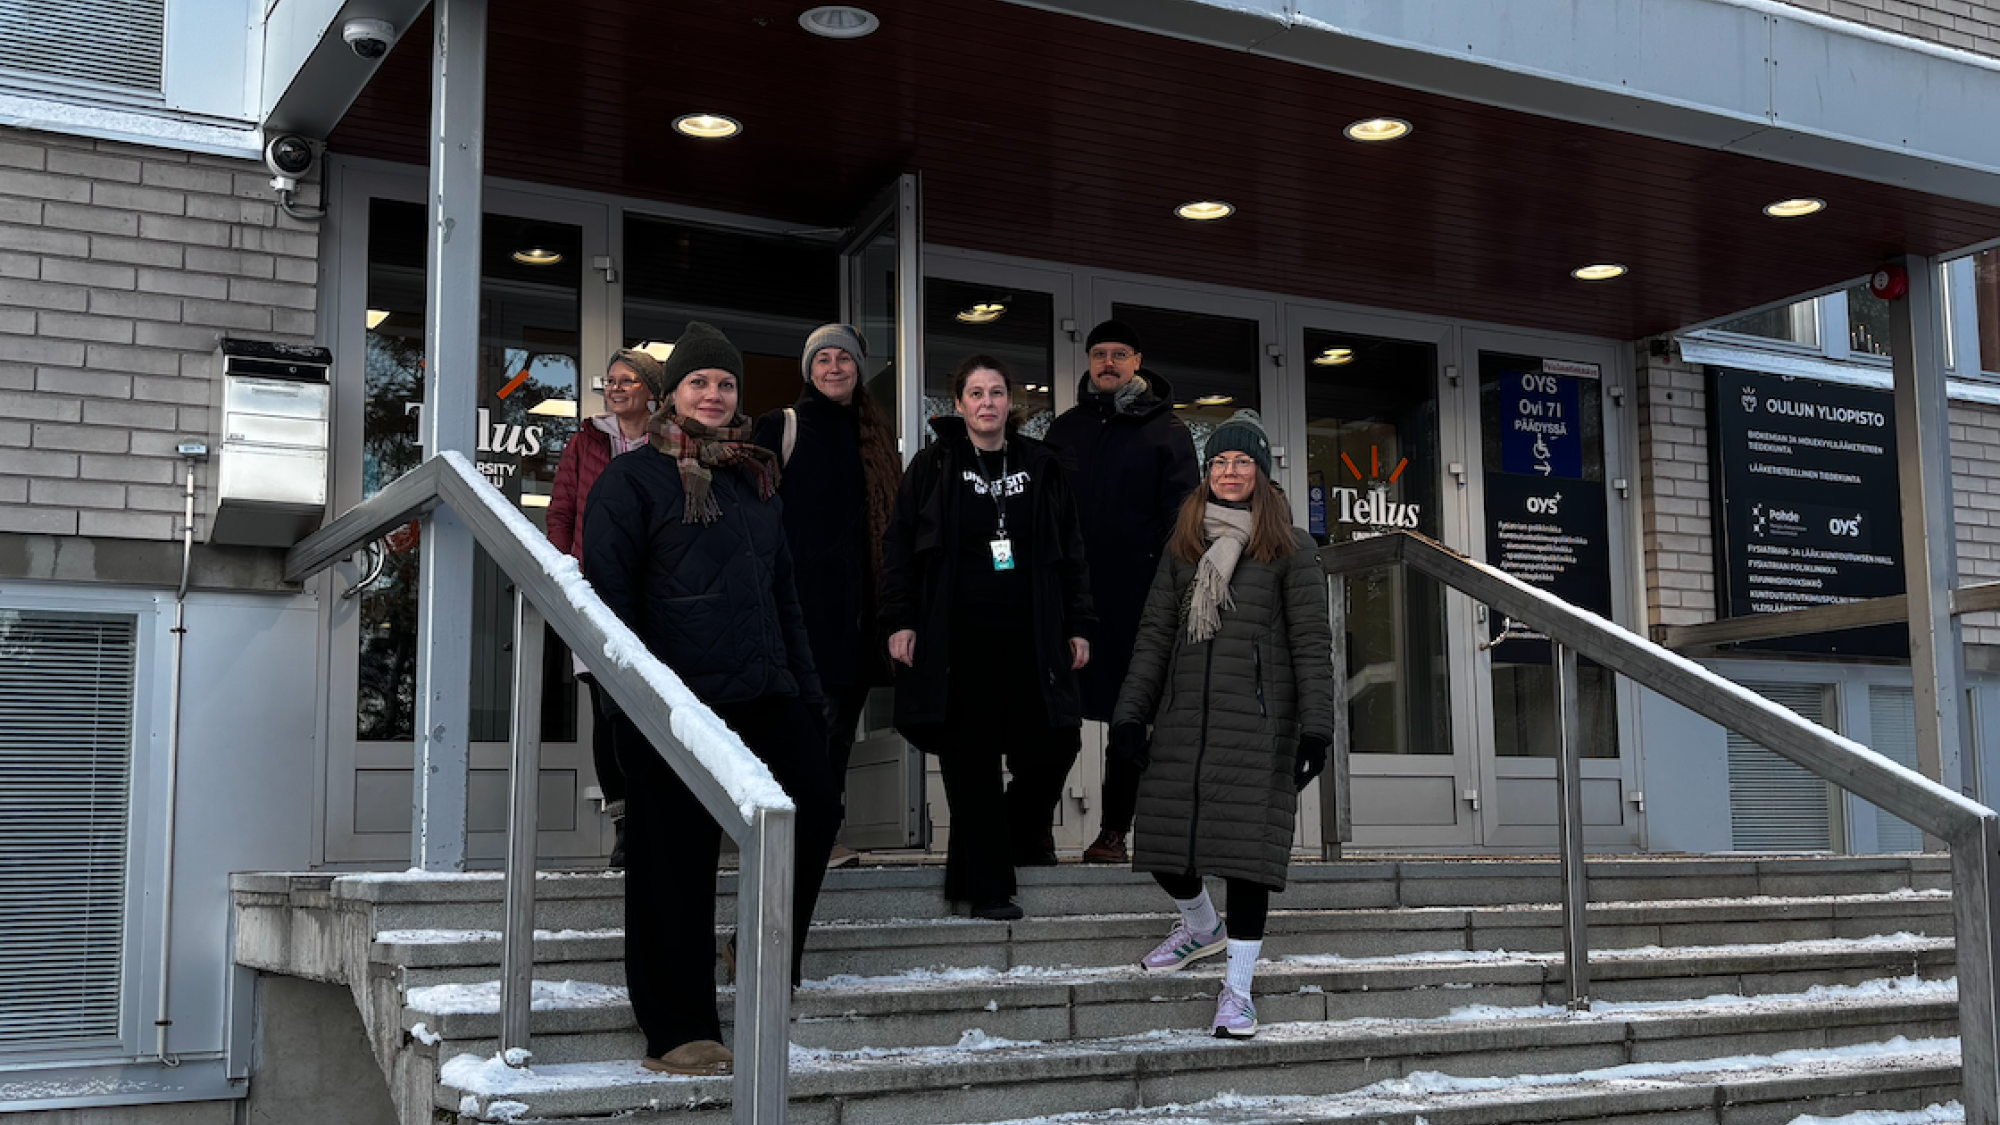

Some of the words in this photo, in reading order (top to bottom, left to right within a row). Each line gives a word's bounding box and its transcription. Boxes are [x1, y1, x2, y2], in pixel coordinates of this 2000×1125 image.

[1522, 374, 1557, 394] OYS
[1519, 399, 1542, 415] Ovi
[1766, 399, 1814, 418] OULUN
[1817, 404, 1884, 427] YLIOPISTO
[405, 402, 543, 457] Tlus
[1514, 417, 1568, 435] PÄÄDYSSÄ
[1331, 486, 1420, 528] Tellus
[1769, 509, 1800, 523] Pohde
